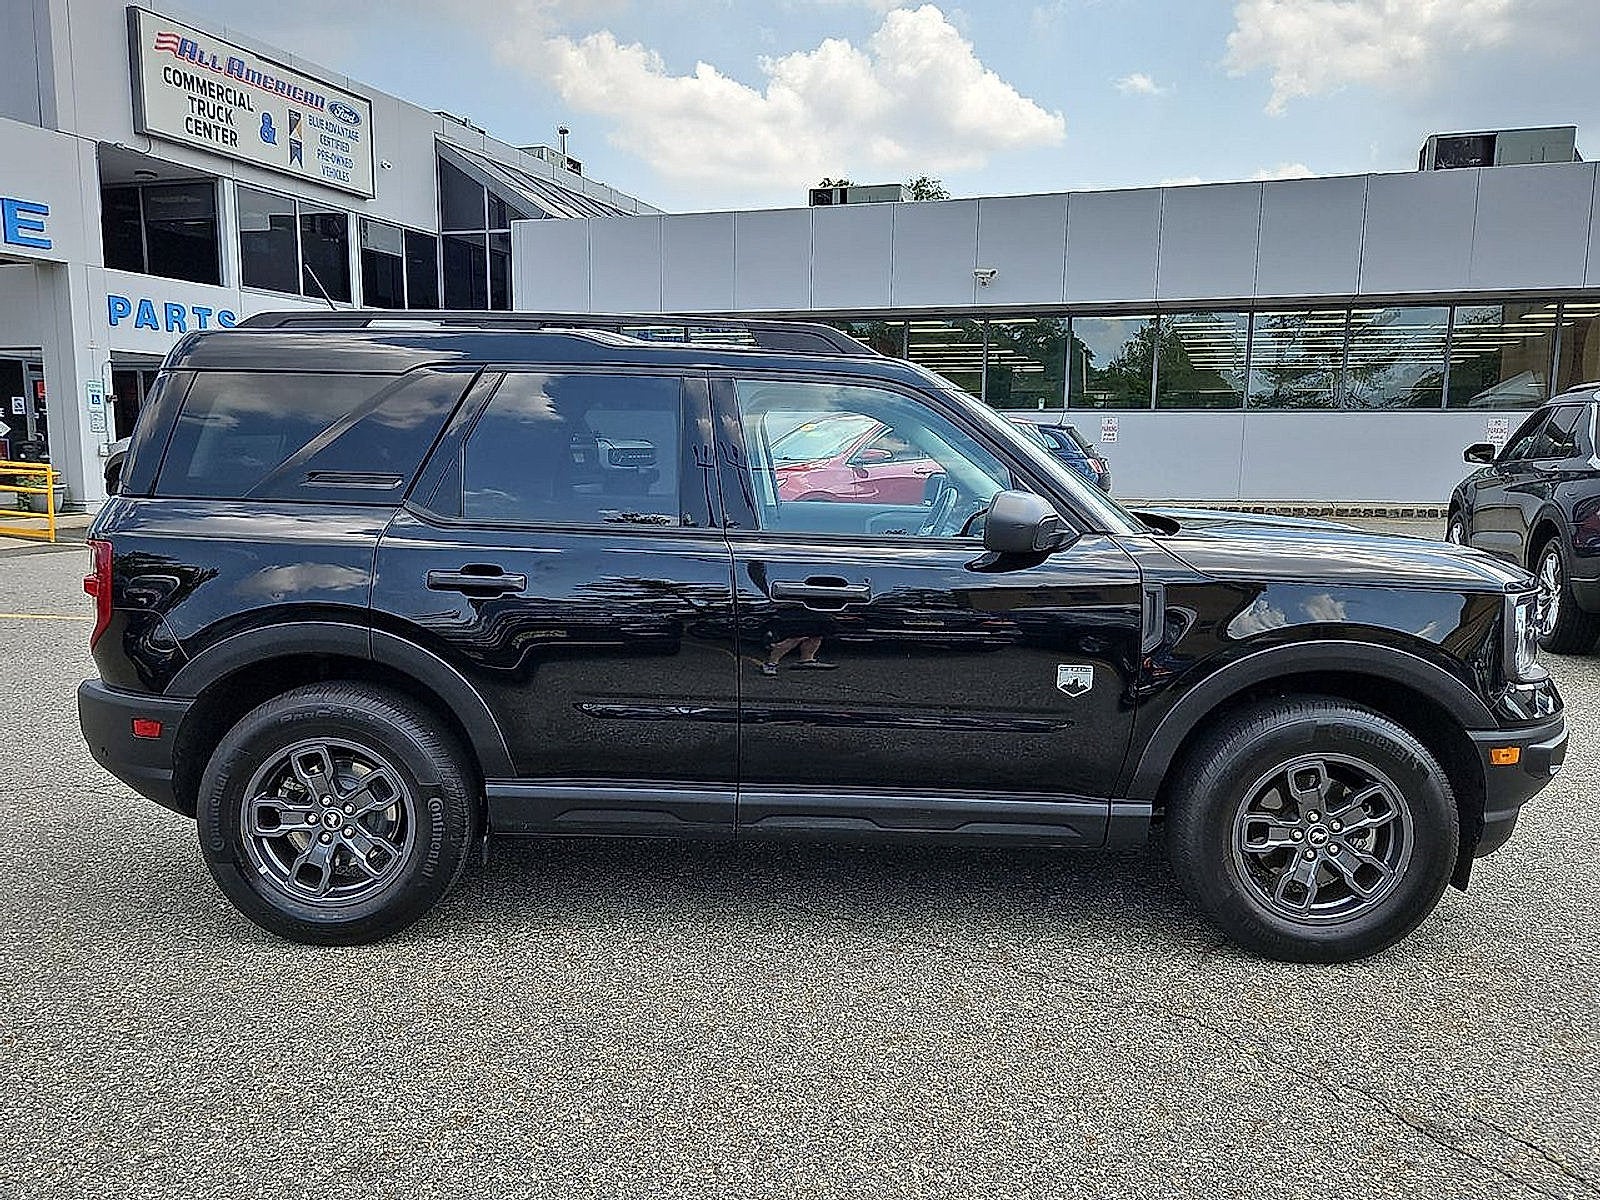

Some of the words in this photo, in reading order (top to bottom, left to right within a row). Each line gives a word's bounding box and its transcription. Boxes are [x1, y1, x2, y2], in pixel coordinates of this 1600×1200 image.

[163, 66, 255, 112] COMMERCIAL
[187, 95, 234, 126] TRUCK
[185, 116, 238, 147] CENTER
[259, 112, 278, 146] &
[106, 294, 238, 334] PARTS
